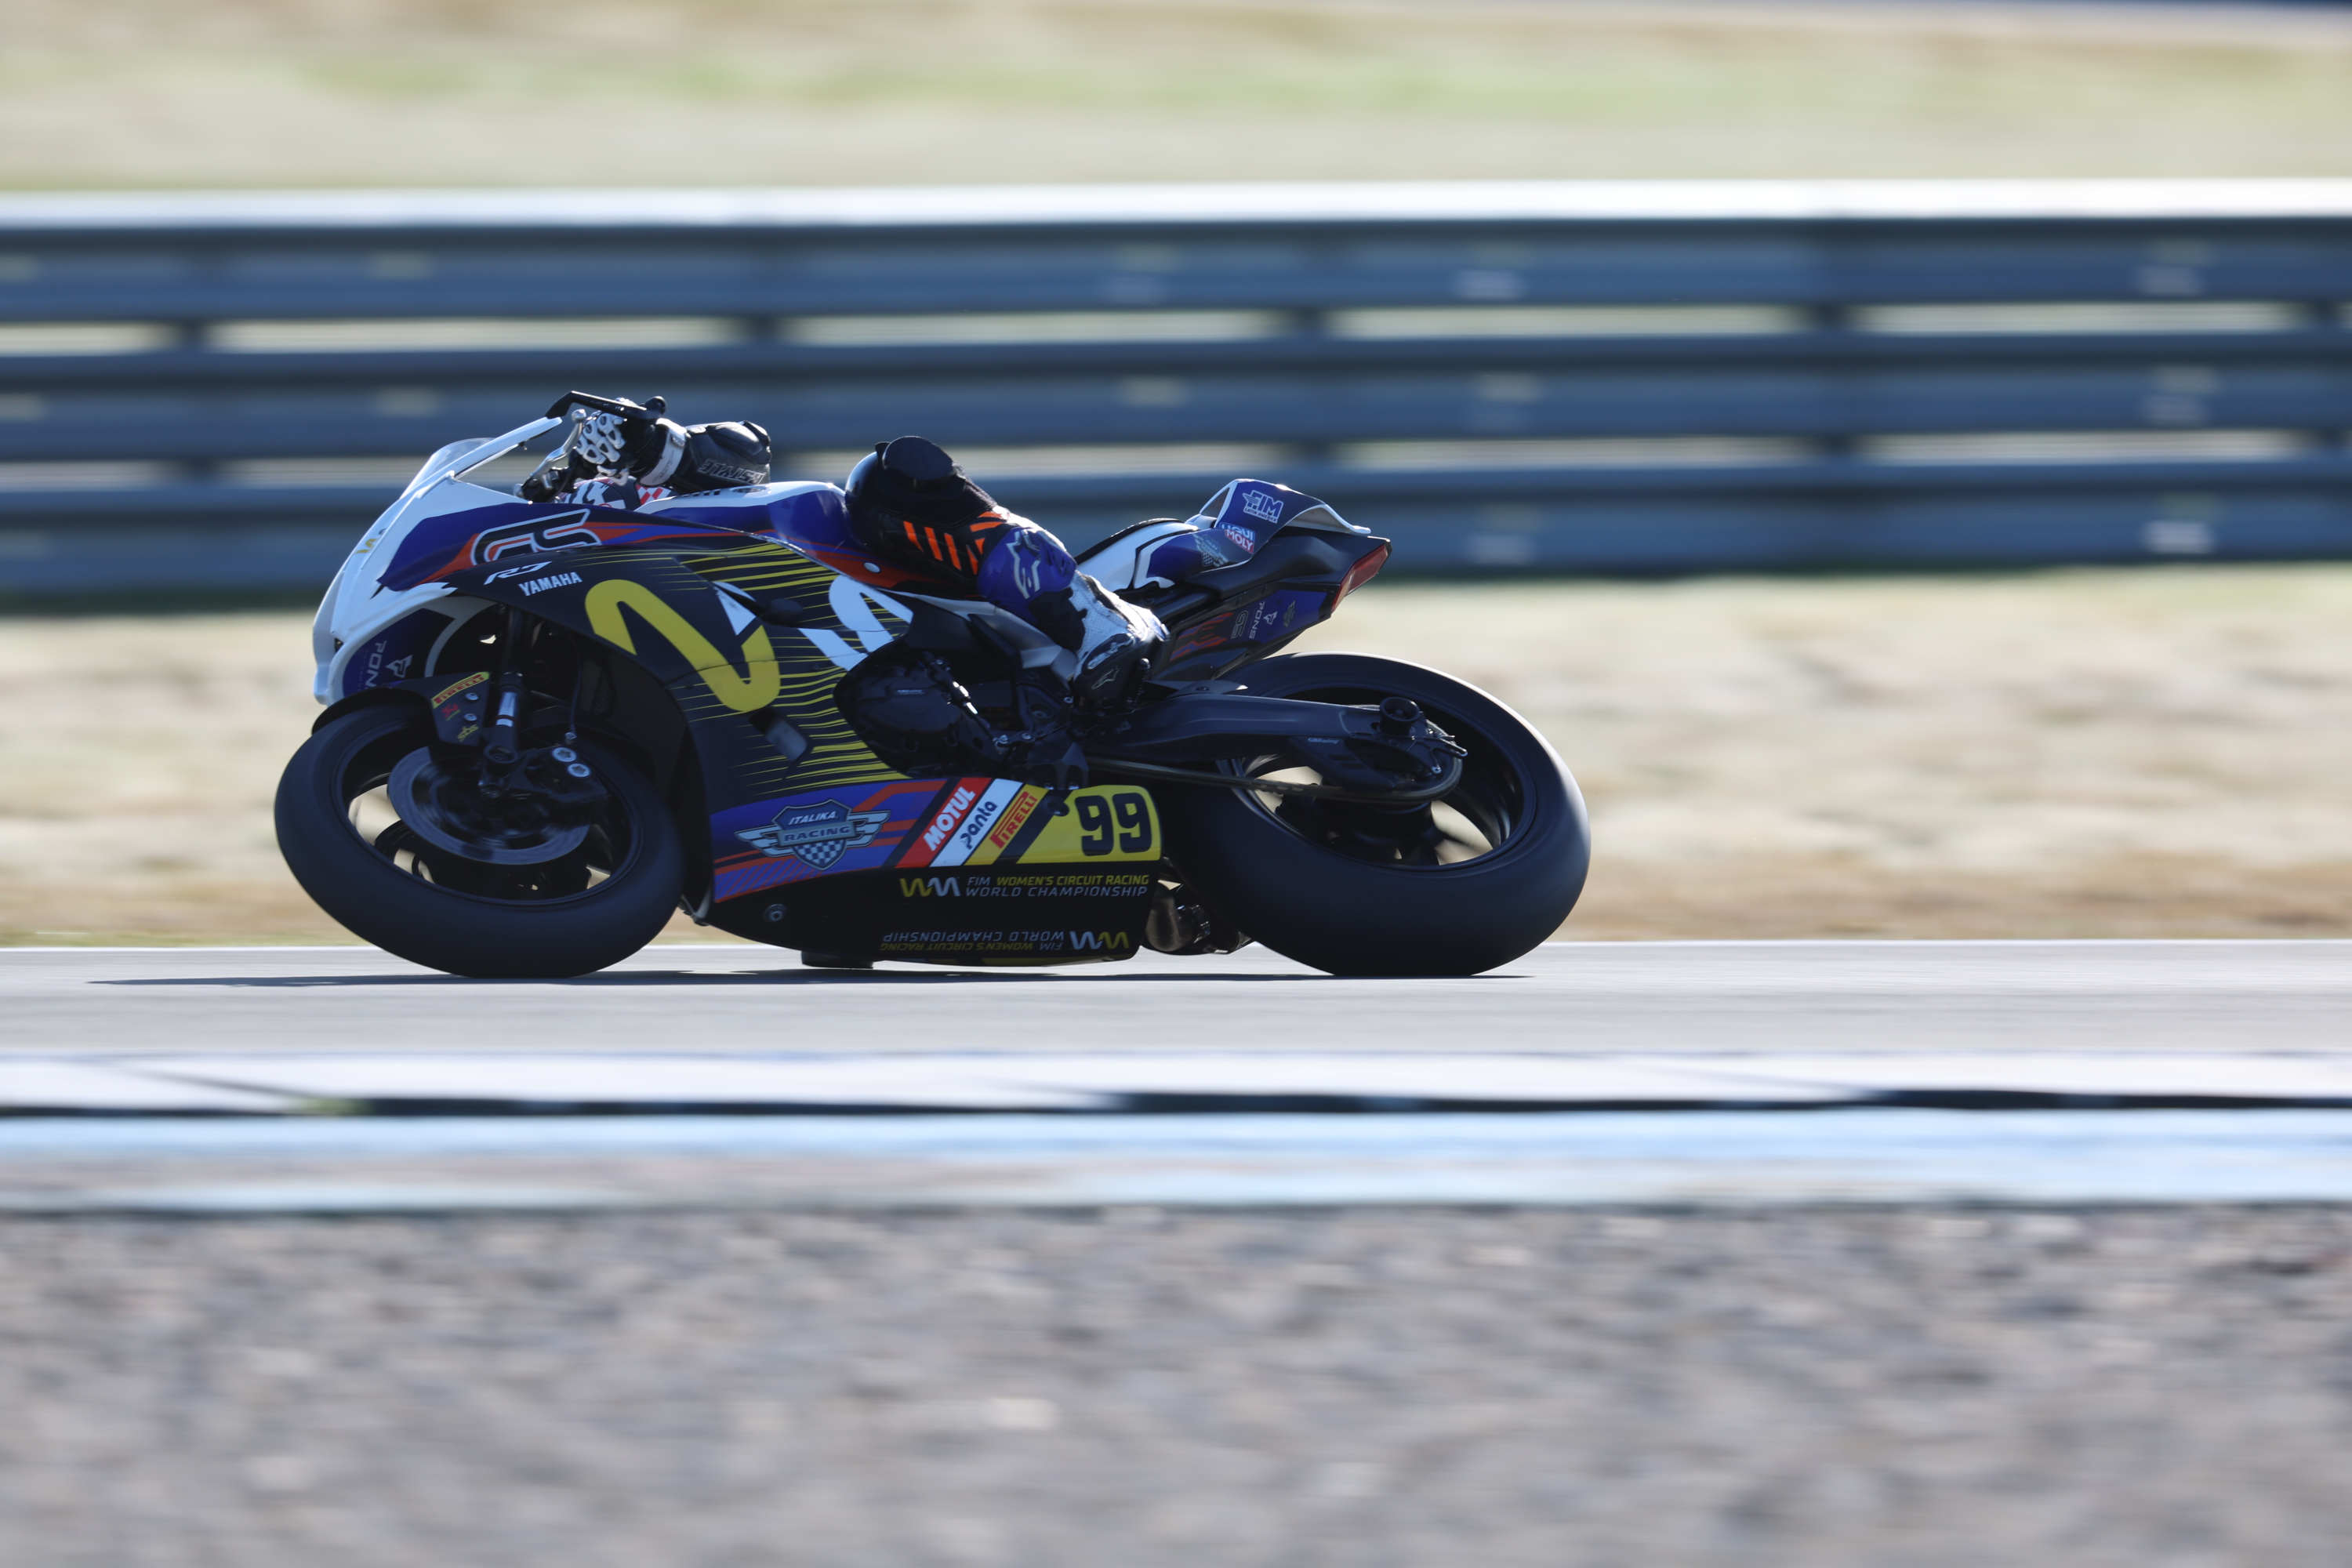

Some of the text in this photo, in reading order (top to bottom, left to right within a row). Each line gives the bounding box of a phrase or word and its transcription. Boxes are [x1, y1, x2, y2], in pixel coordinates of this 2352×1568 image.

[1226, 528, 1254, 551] MOLY
[484, 561, 552, 585] R7
[518, 572, 583, 597] YAMAHA
[364, 640, 387, 688] PON
[788, 811, 837, 826] ITALIKA
[924, 786, 976, 851] MOTUL
[989, 791, 1038, 849] PIRELLI
[1074, 793, 1152, 857] 99
[784, 826, 851, 841] RACING
[965, 886, 1149, 897] WORLD CHAMPIONSHIP
[967, 875, 1149, 886] FIM WOMEN'S CIRCUIT RACING
[882, 931, 1065, 942] WORLD CHAMPIONSHIP
[1040, 942, 1062, 950] FIM
